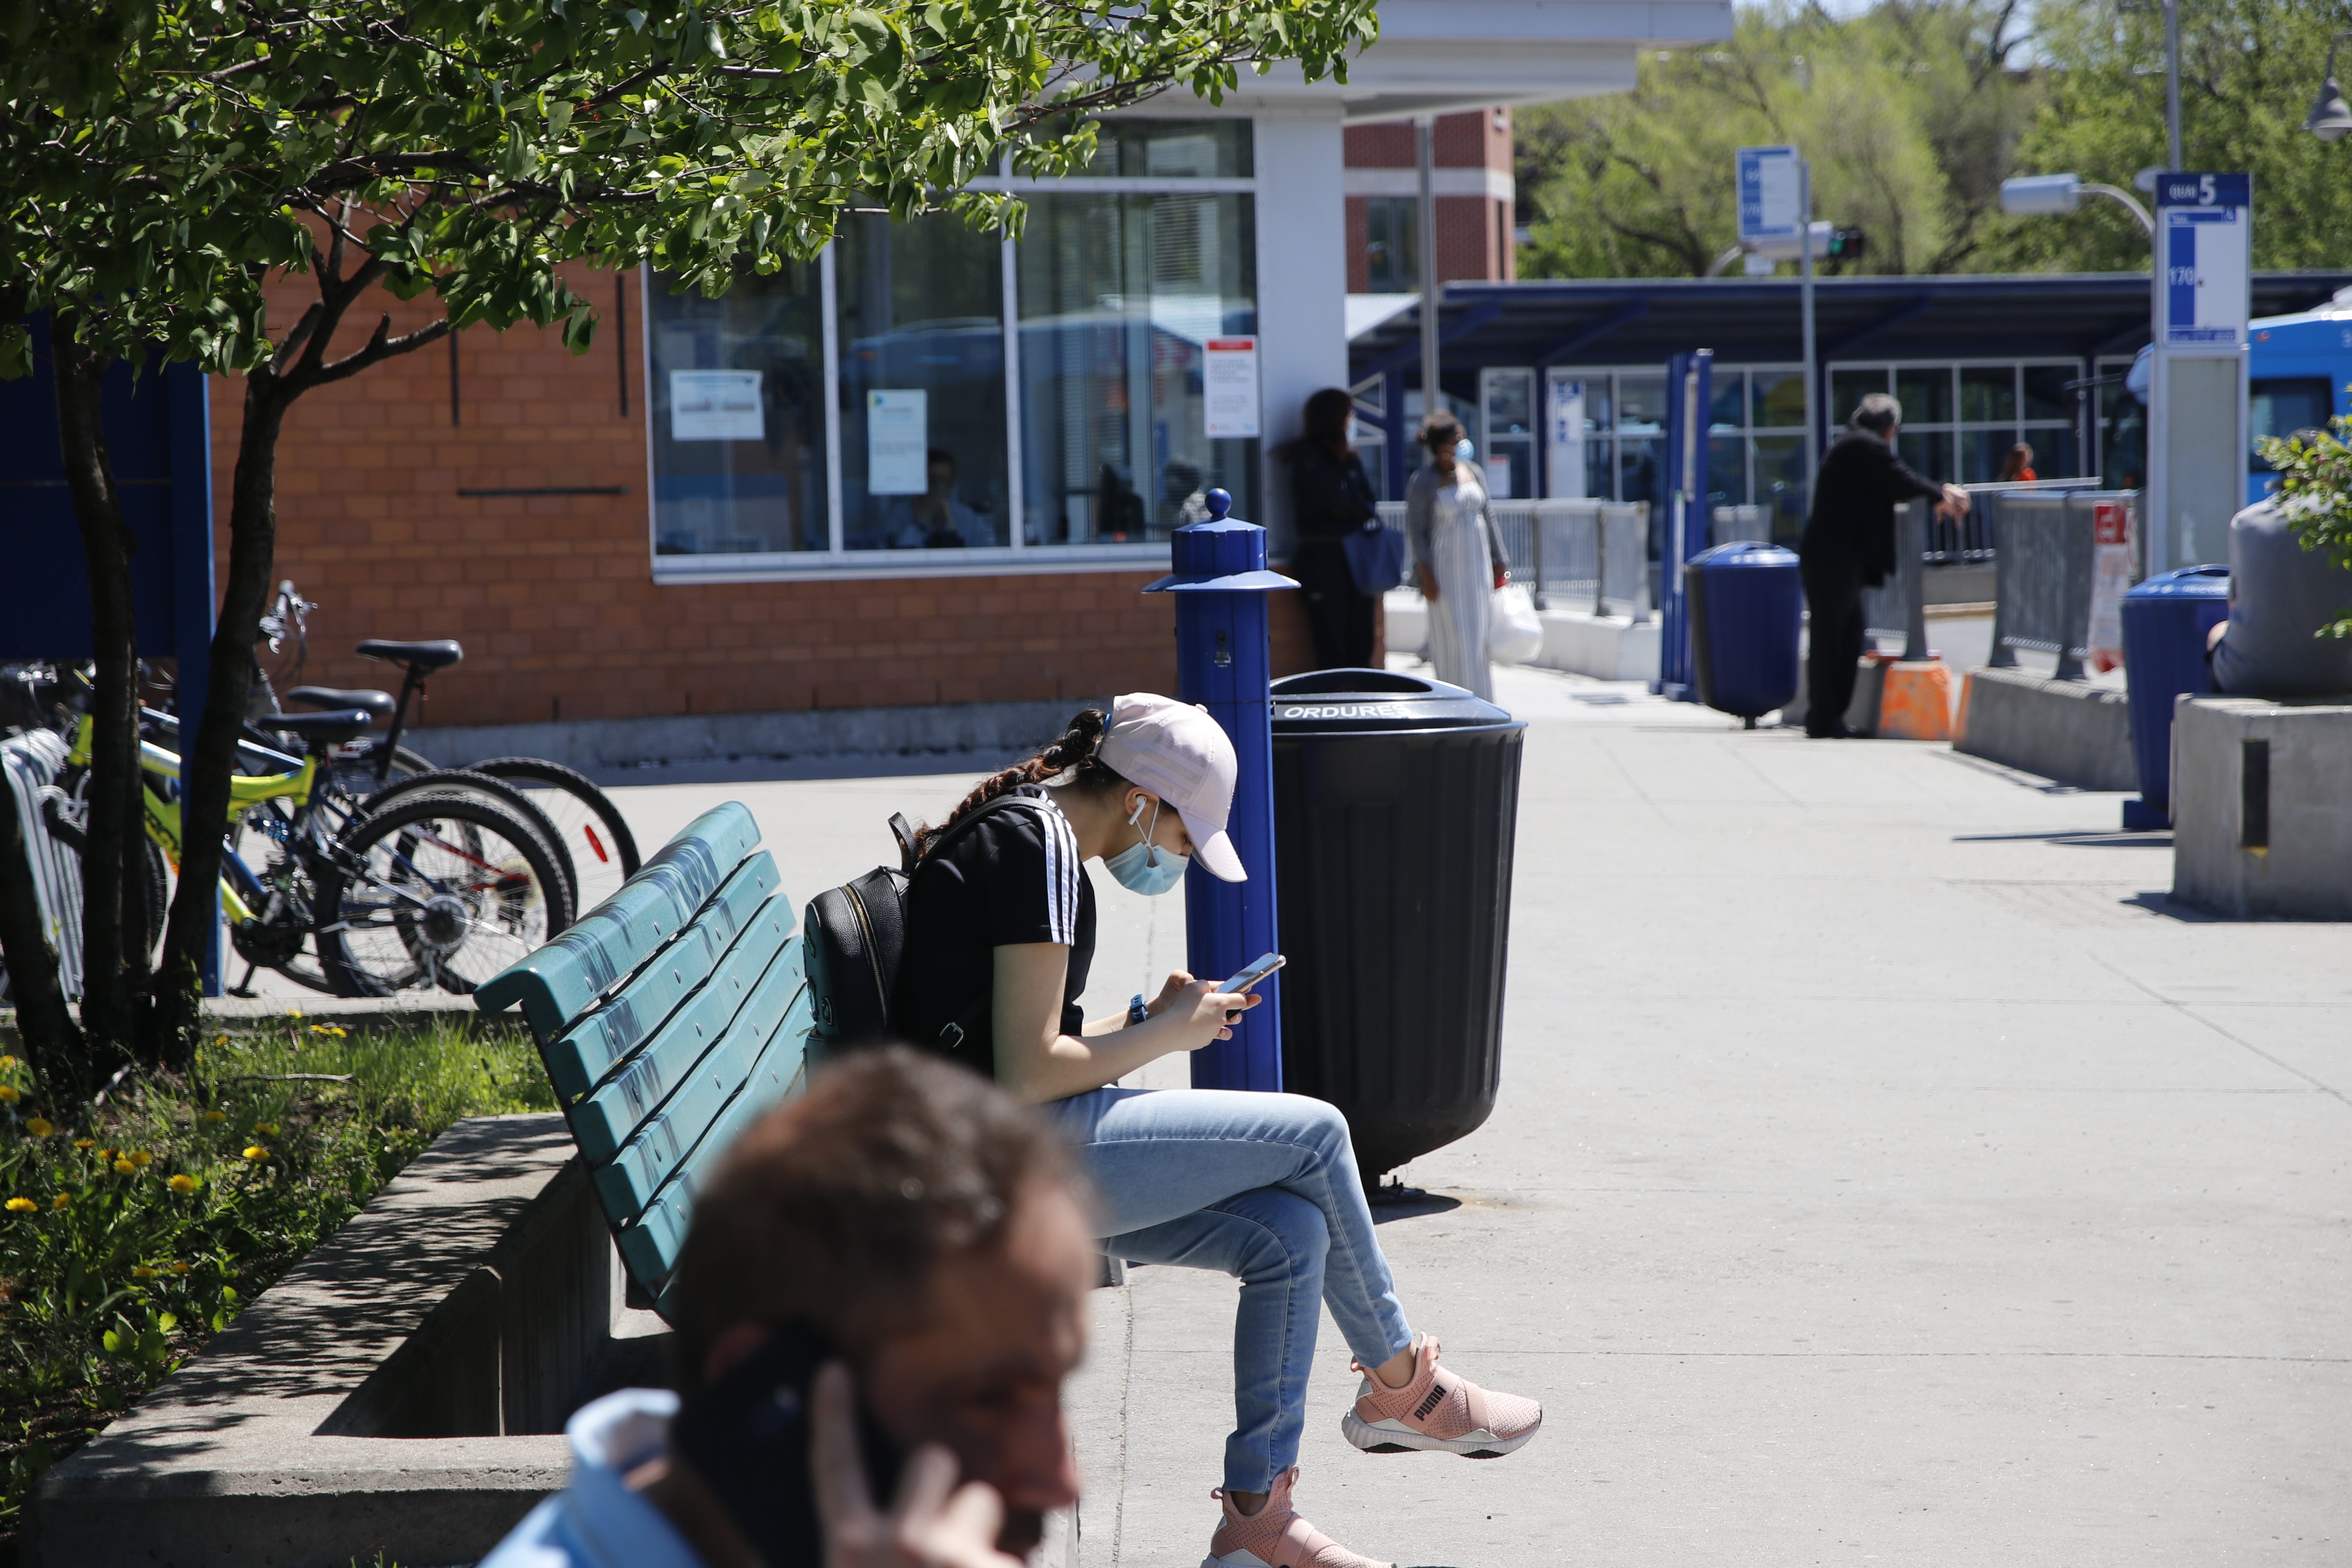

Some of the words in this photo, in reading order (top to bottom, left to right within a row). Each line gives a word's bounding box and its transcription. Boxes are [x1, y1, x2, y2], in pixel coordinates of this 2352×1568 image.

[2169, 183, 2198, 200] QUAI
[2199, 174, 2217, 206] 5
[2168, 266, 2196, 286] 170
[1283, 704, 1412, 719] ORDURES
[1414, 1385, 1446, 1422] PUMA
